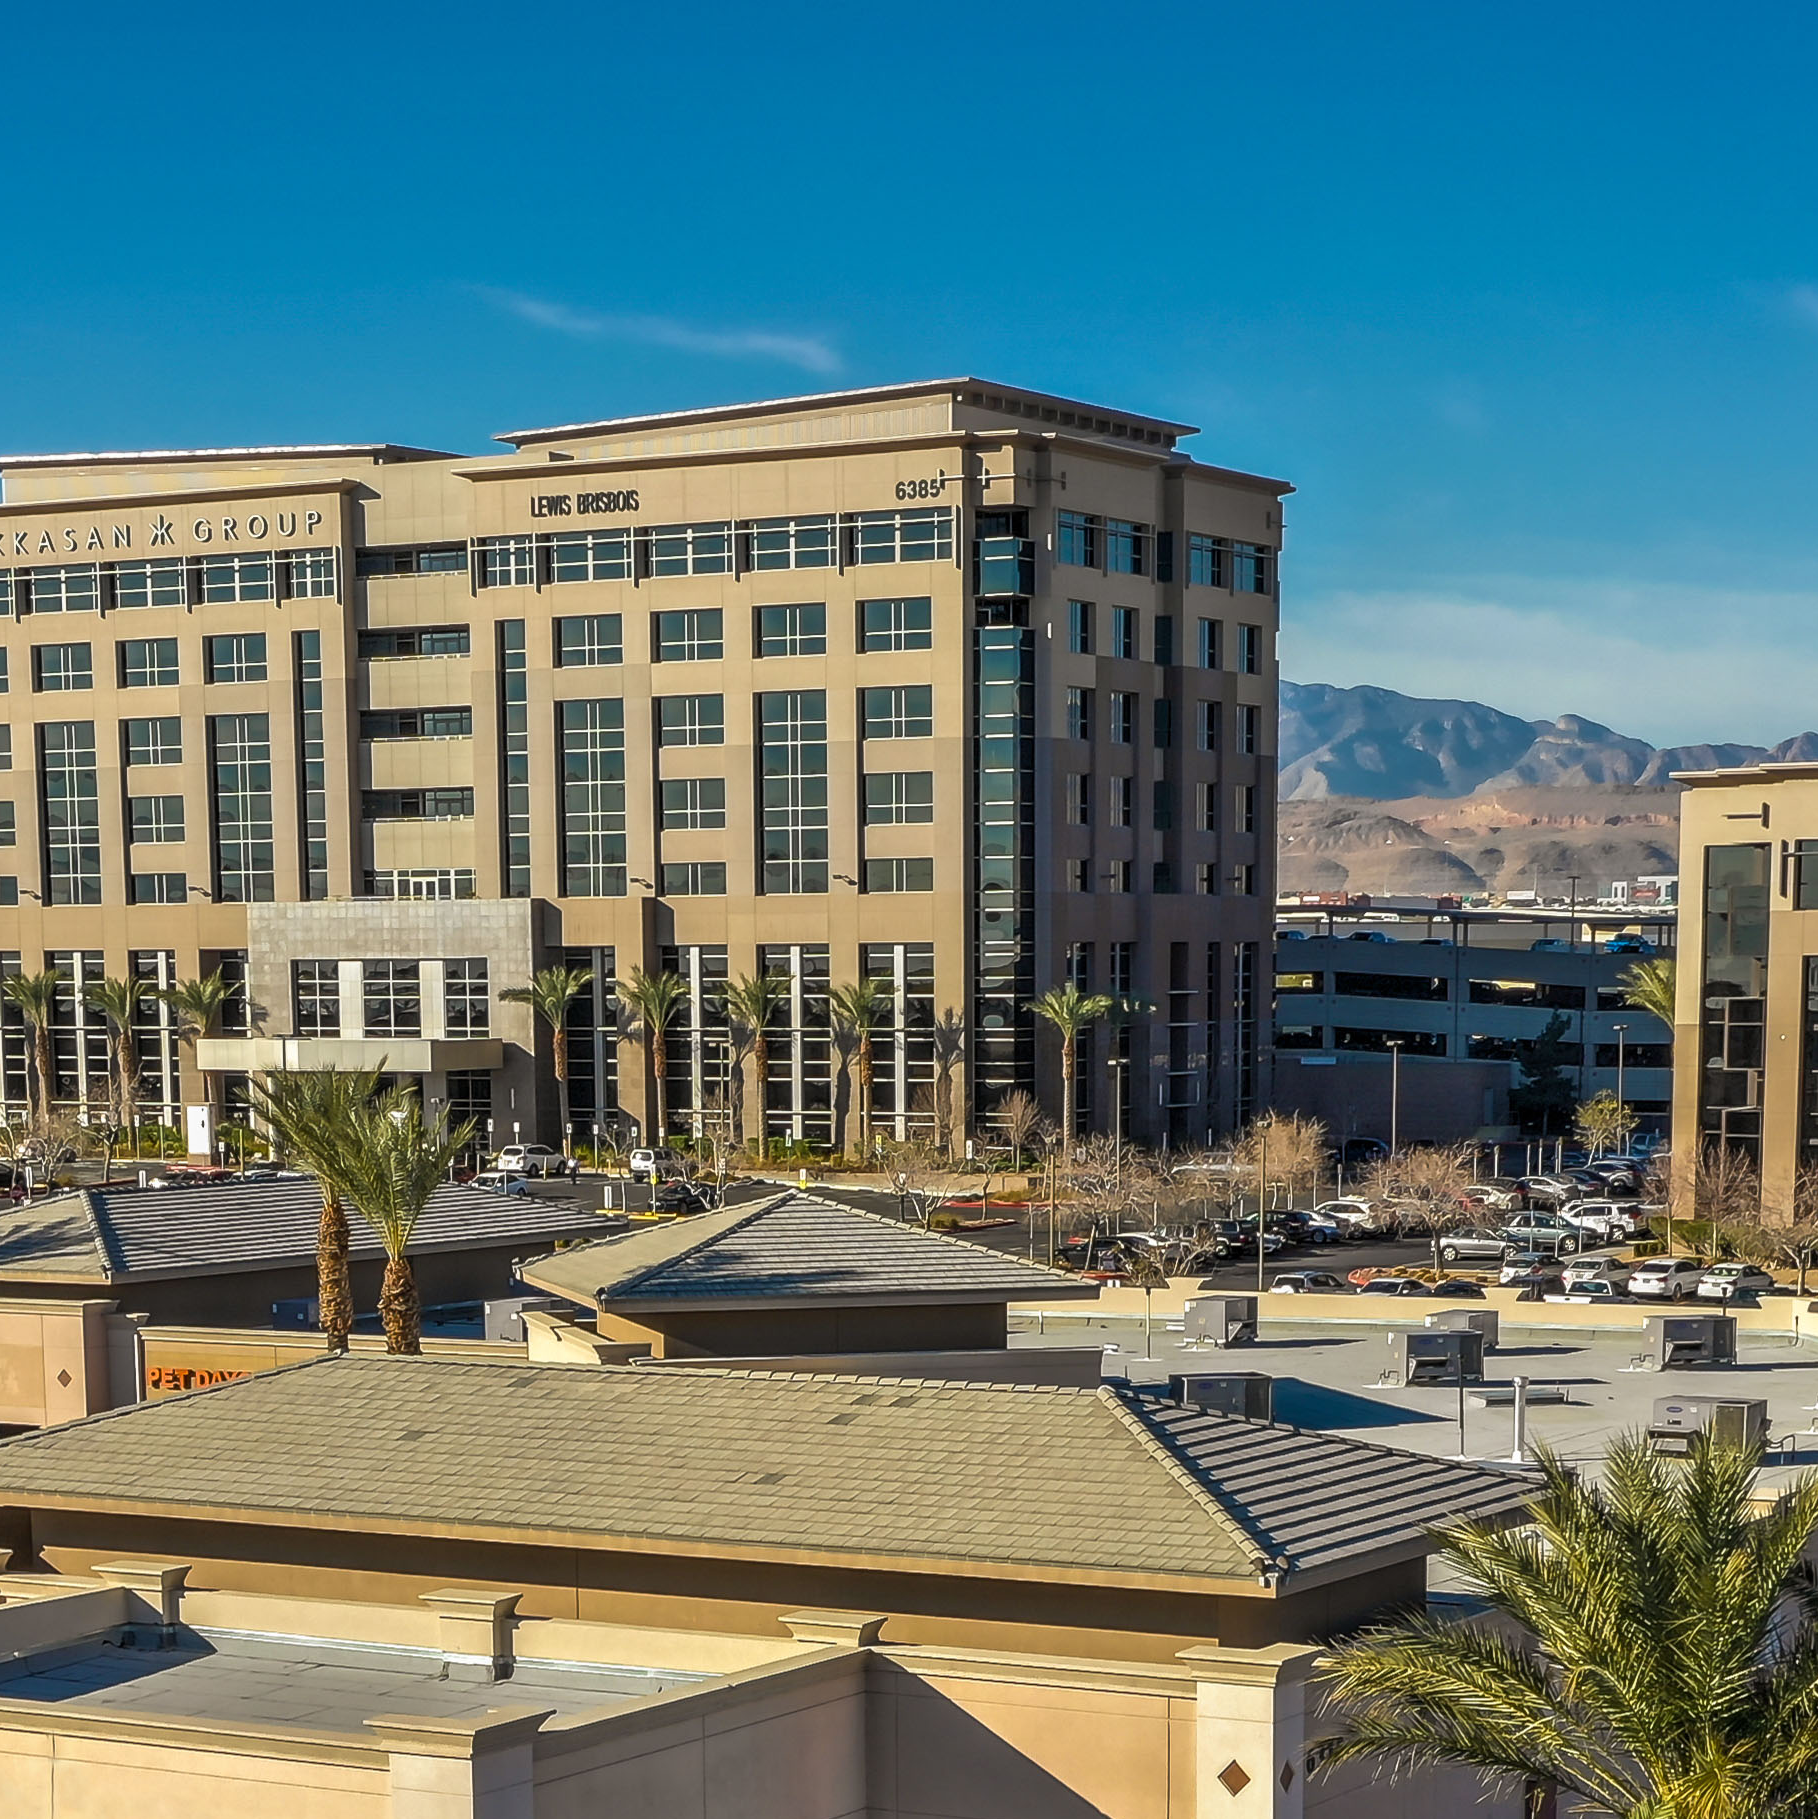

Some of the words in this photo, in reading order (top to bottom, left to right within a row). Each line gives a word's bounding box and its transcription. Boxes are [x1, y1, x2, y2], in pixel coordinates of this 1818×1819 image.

[895, 478, 941, 501] 6385
[530, 495, 572, 518] LEWIS
[576, 489, 640, 515] BRISBOIS
[192, 510, 323, 544] GROUP
[146, 1367, 190, 1390] PET
